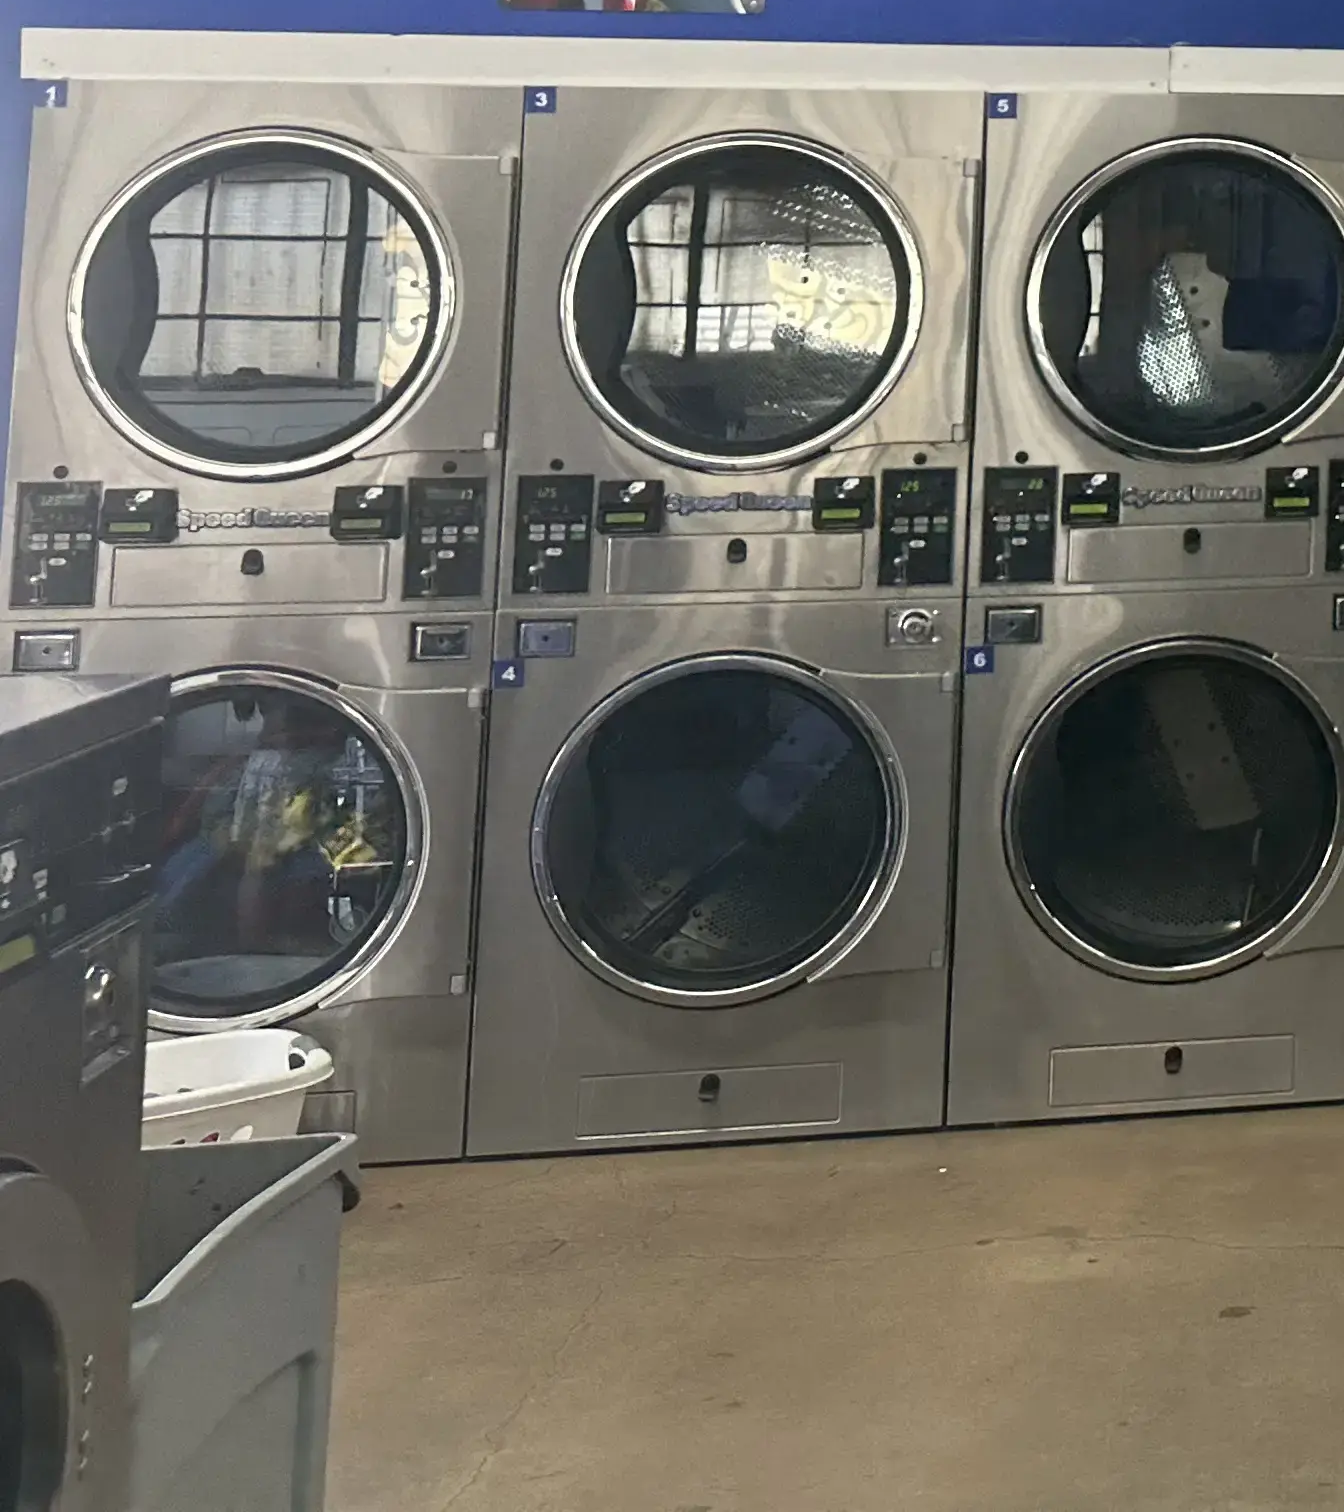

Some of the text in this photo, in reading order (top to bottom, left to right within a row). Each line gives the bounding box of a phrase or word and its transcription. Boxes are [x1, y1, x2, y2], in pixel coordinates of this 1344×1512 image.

[45, 86, 57, 101] 1
[535, 92, 547, 107] 3
[997, 99, 1009, 112] 5
[973, 653, 986, 667] 6
[501, 666, 515, 681] 4
